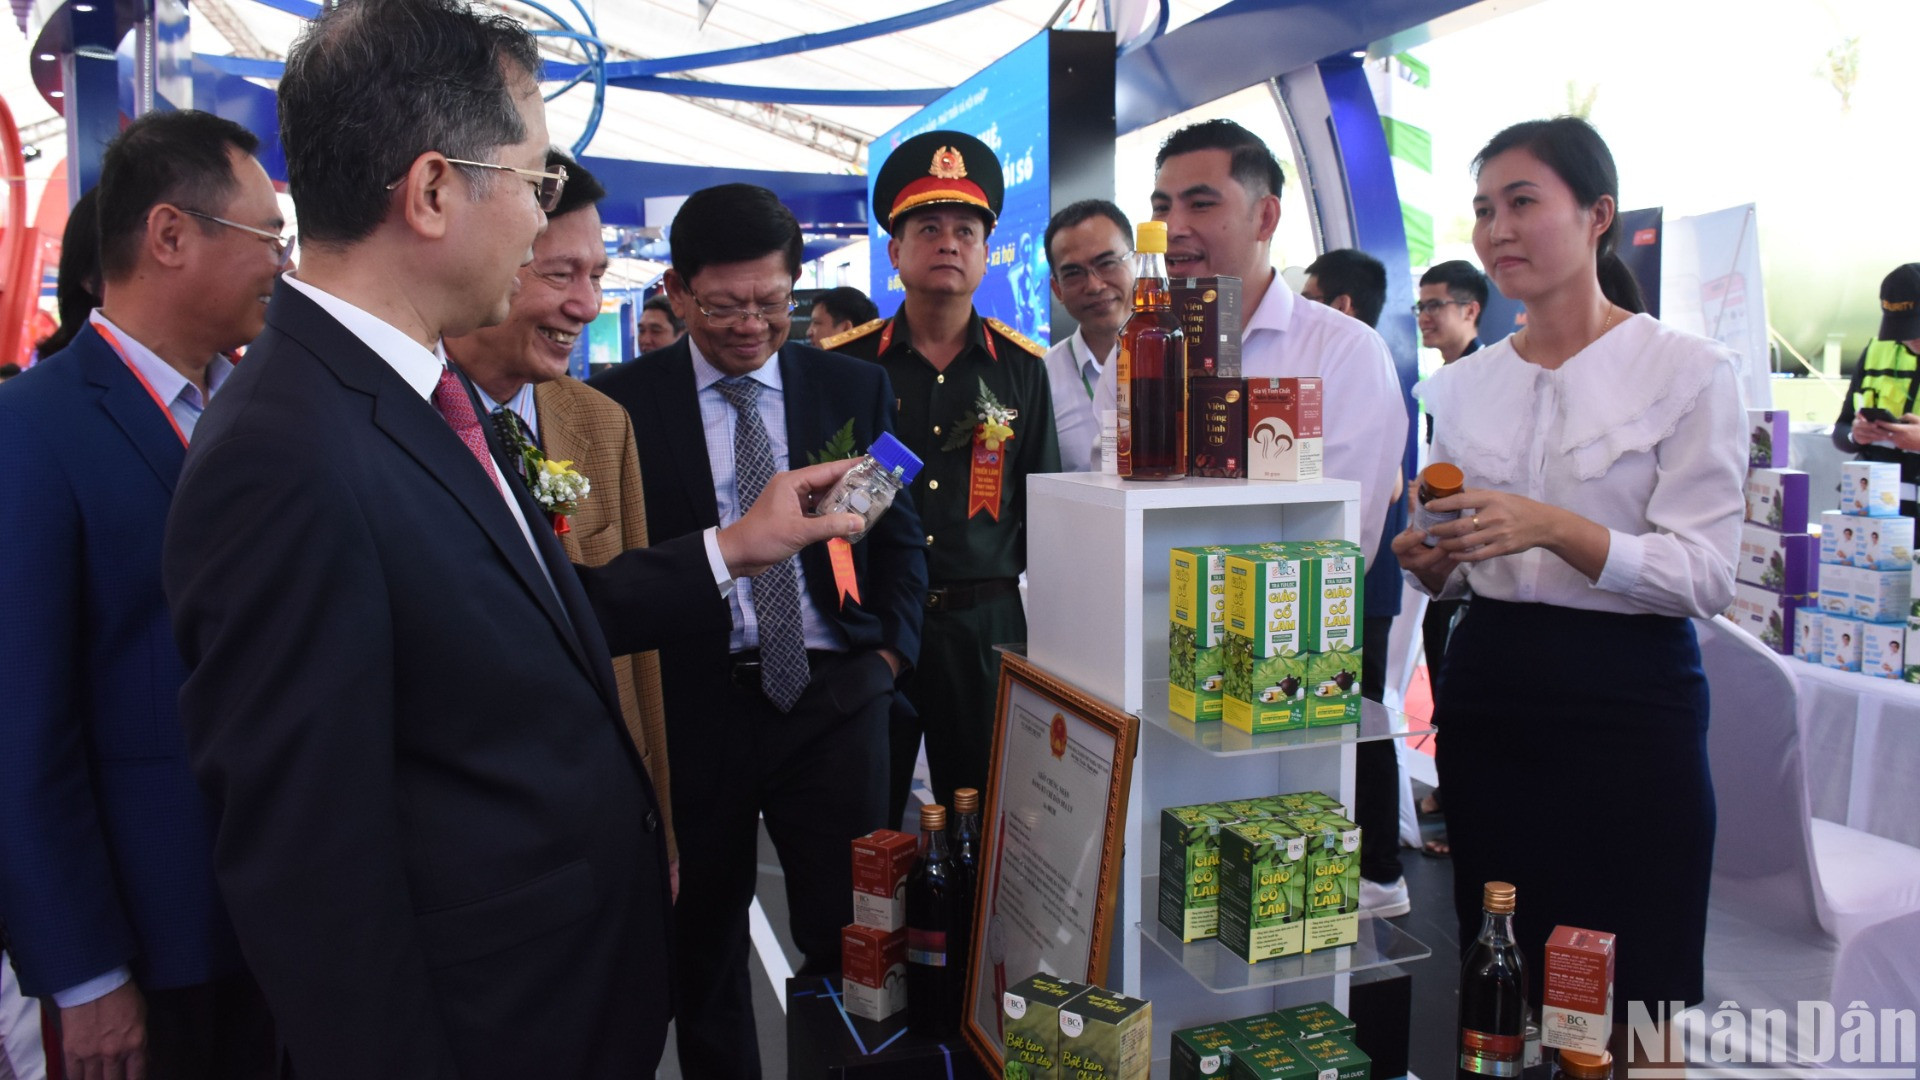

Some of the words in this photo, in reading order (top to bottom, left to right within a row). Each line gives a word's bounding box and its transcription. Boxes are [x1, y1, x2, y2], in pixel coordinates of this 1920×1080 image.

[1016, 145, 1034, 184] SỐ
[1001, 242, 1016, 267] hội
[1207, 402, 1226, 411] Viên
[1206, 413, 1227, 423] Uống
[1207, 424, 1226, 433] Linh
[1209, 434, 1223, 444] Chi
[1269, 620, 1296, 632] LAM
[1324, 615, 1350, 627] LAM
[1193, 886, 1220, 897] LAM
[1314, 893, 1341, 907] LAM
[1259, 902, 1286, 916] LAM
[1006, 1032, 1024, 1048] Bột
[1026, 1039, 1045, 1053] tan
[1062, 1051, 1081, 1068] Bột
[1083, 1058, 1104, 1072] tan
